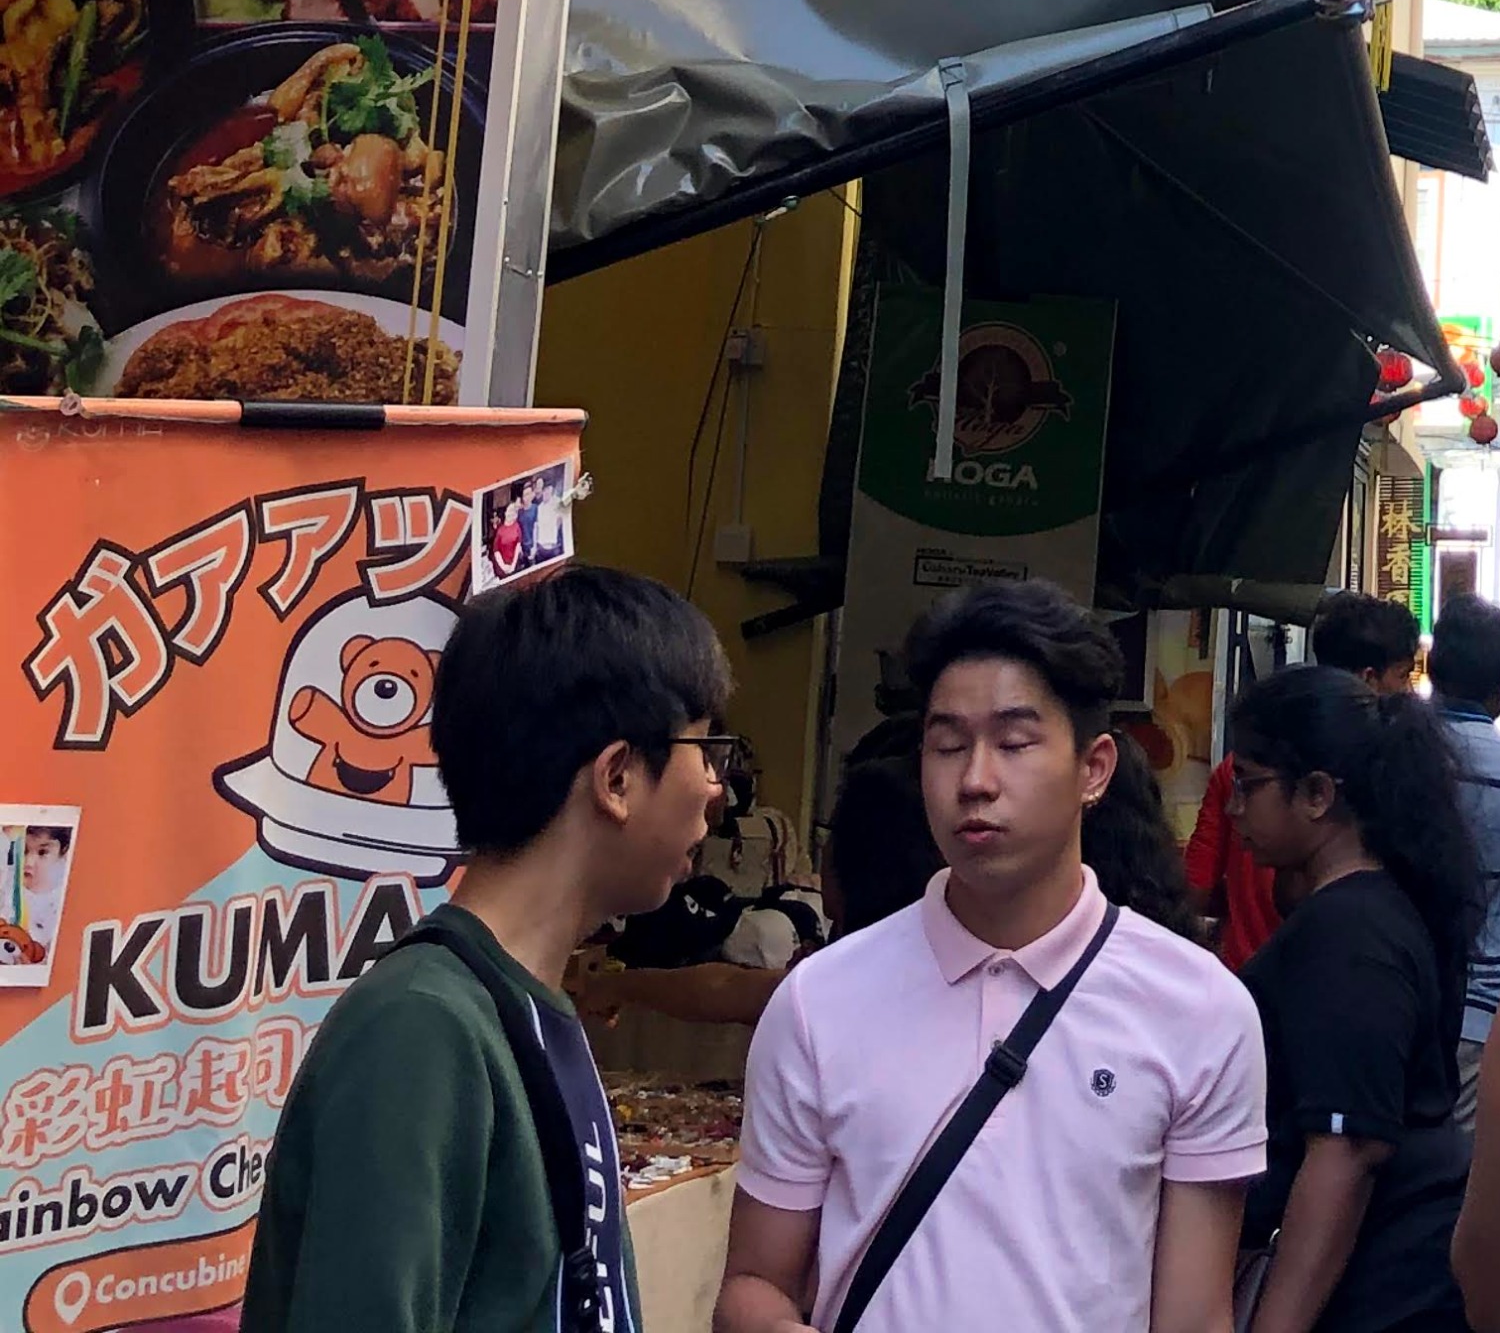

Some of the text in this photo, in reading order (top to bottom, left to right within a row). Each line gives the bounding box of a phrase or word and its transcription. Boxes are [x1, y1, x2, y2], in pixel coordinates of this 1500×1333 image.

[82, 883, 416, 1029] KUMA
[7, 1026, 294, 1157] 彩虹起司
[95, 1251, 246, 1303] Concubine
